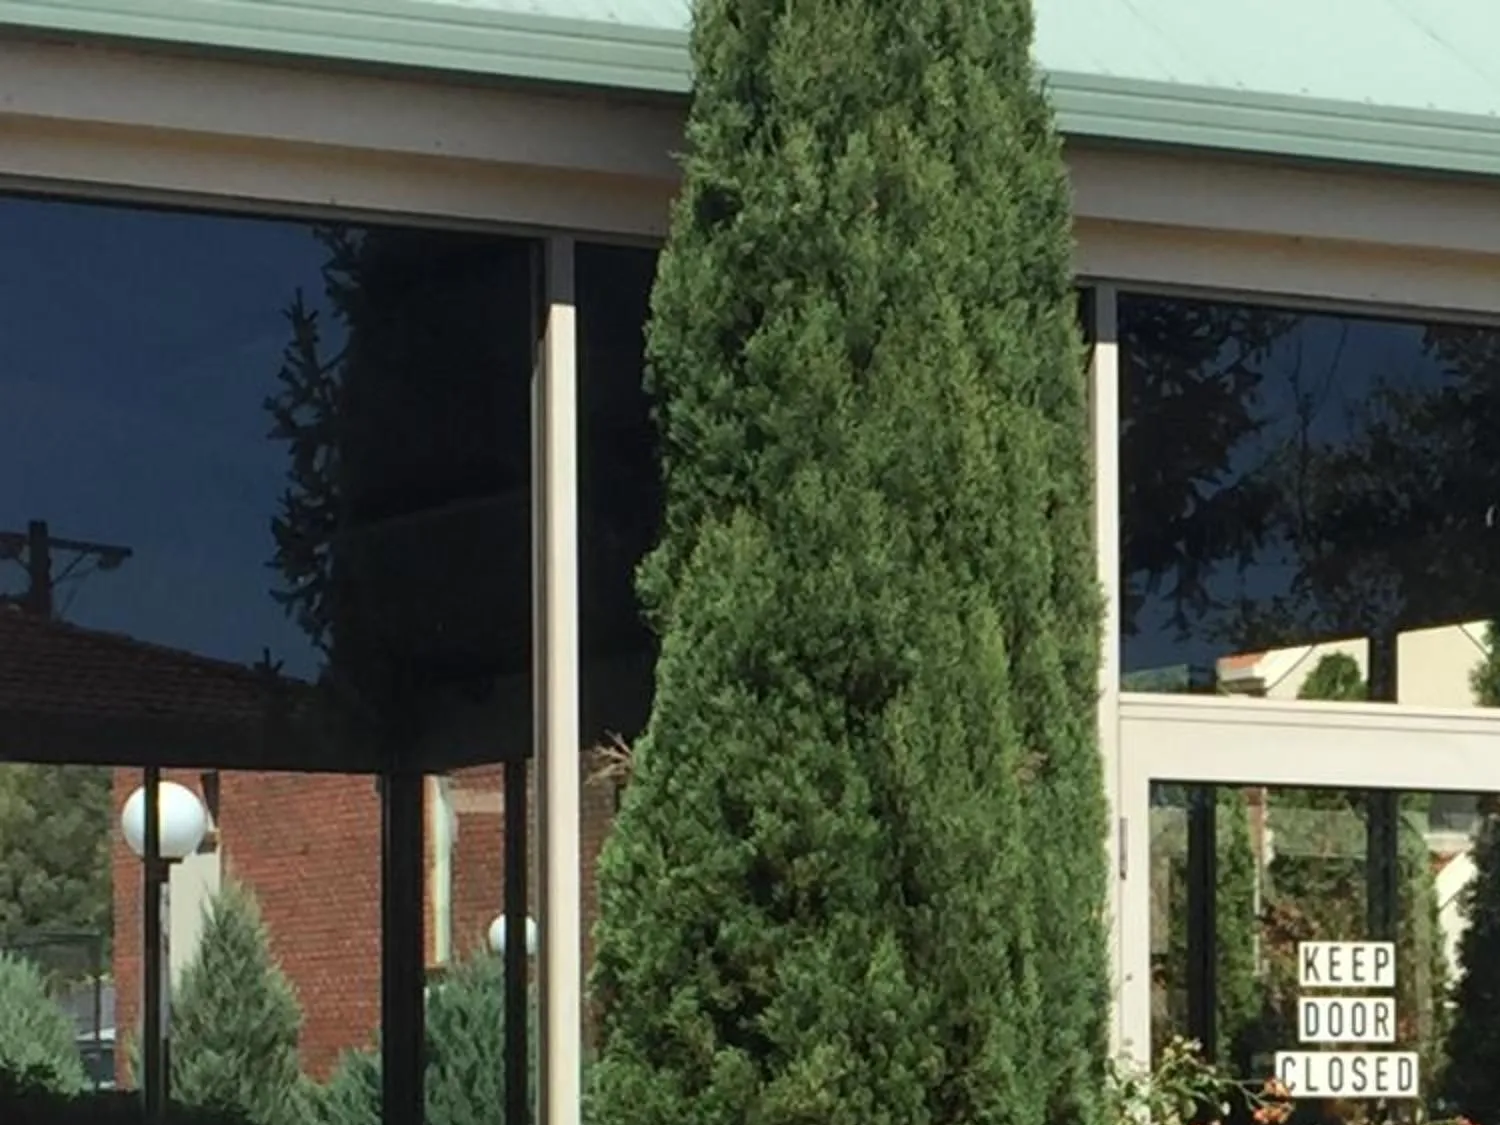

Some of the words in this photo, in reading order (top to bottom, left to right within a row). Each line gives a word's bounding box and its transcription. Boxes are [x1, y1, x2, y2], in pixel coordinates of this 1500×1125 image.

[1304, 946, 1389, 982] KEEP
[1304, 1001, 1389, 1037] DOOR
[1281, 1056, 1412, 1092] CLOSED
